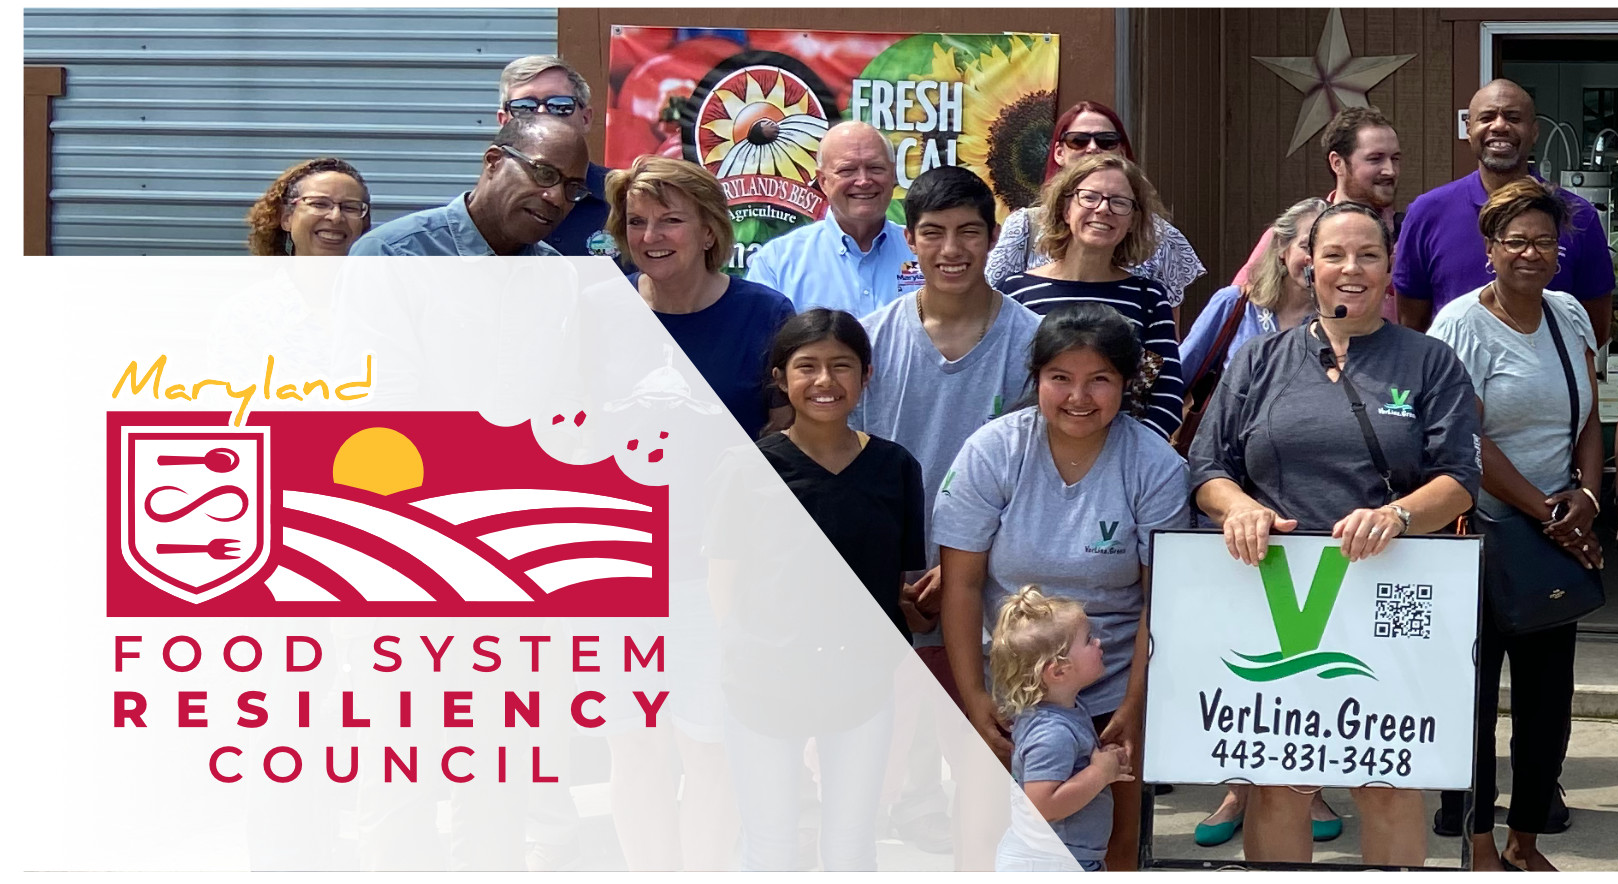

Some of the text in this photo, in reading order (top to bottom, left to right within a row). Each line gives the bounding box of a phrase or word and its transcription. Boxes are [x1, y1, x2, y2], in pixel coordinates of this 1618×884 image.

[852, 79, 963, 132] FRESH
[728, 204, 797, 224] Agriculture
[787, 183, 823, 214] BEST
[1199, 687, 1436, 744] VerLina.Green
[1211, 738, 1412, 778] 443-831-3458
